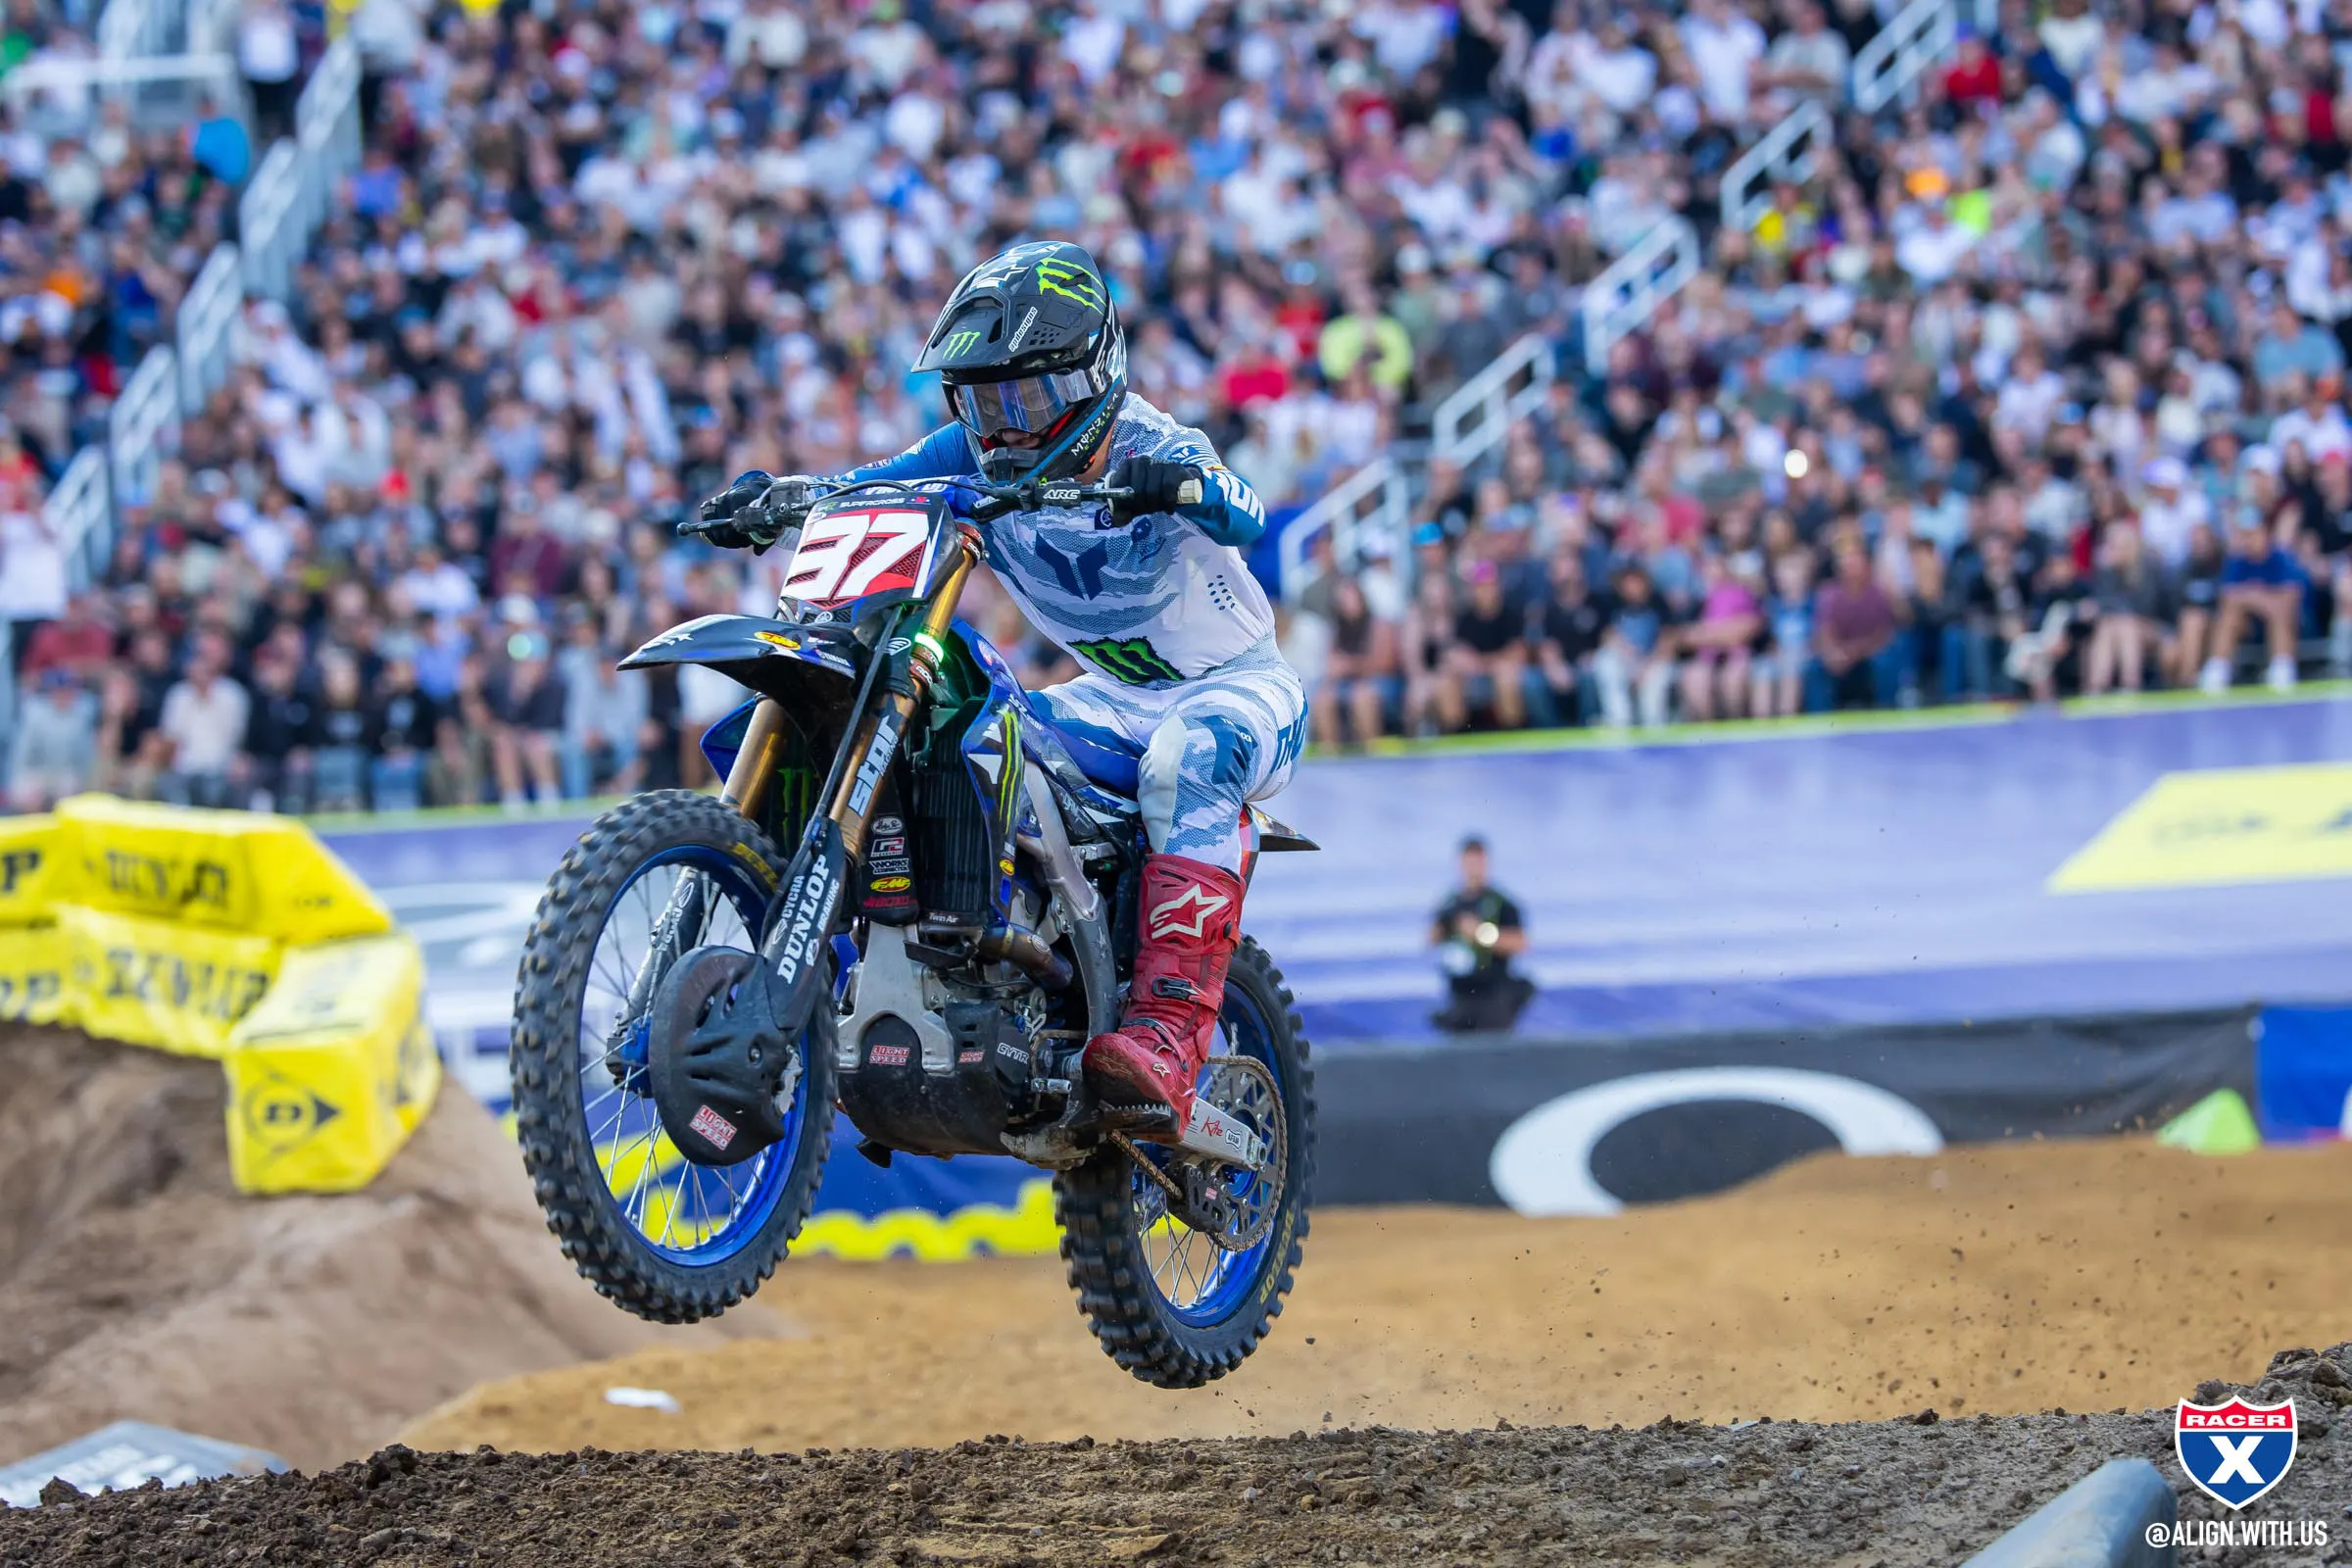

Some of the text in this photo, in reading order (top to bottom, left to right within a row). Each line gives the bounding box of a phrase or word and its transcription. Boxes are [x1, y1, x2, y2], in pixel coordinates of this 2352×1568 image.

[839, 497, 906, 509] SUPERCROSS
[1043, 489, 1081, 500] ARC
[781, 513, 929, 601] 37
[870, 858, 908, 869] WORKS
[781, 875, 805, 918] CYCRA
[817, 878, 840, 933] BRAKING
[777, 854, 829, 985] DUNLOP
[946, 914, 959, 923] Air
[869, 1054, 907, 1065] SPEED
[872, 1045, 910, 1055] LIGHT
[997, 1042, 1030, 1064] GYTR
[692, 1119, 728, 1147] SPEED
[699, 1107, 736, 1140] LIGHT
